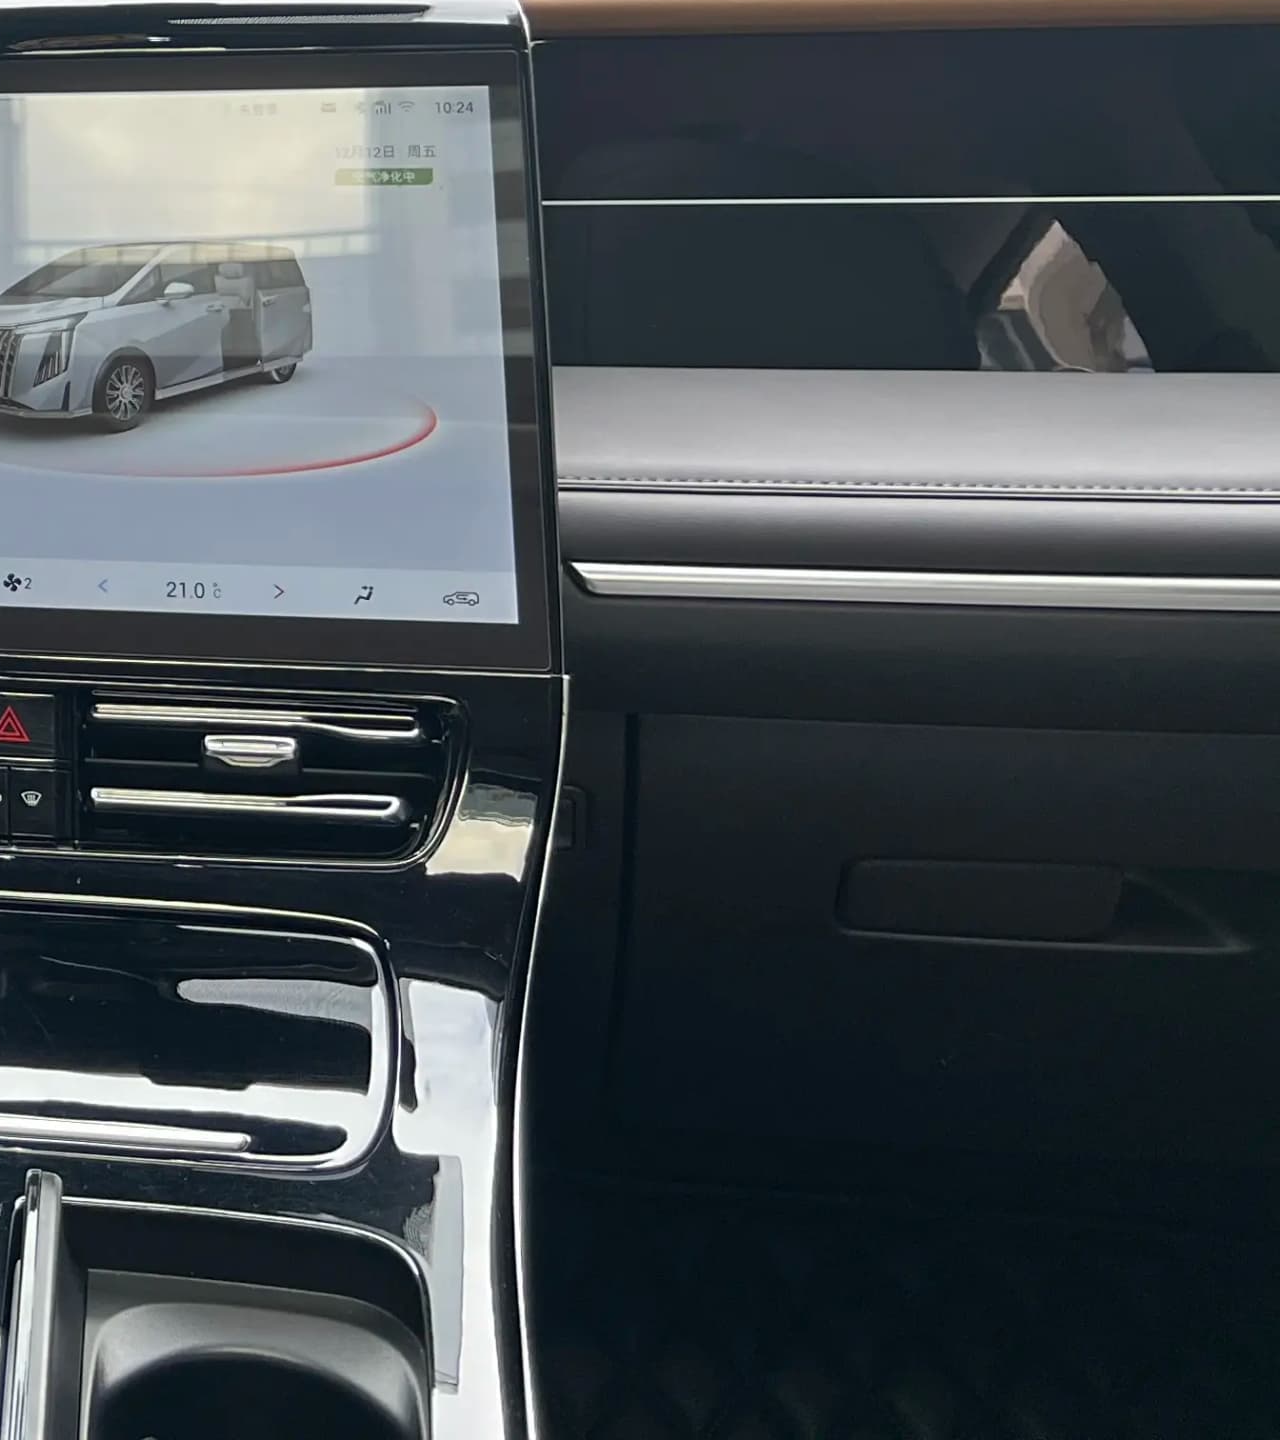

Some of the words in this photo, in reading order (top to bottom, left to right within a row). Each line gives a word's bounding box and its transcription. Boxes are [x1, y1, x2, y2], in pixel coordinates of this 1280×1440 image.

[435, 101, 474, 114] 10:24
[407, 144, 436, 159] 周五
[24, 577, 32, 590] 2
[166, 581, 205, 599] 21.0
